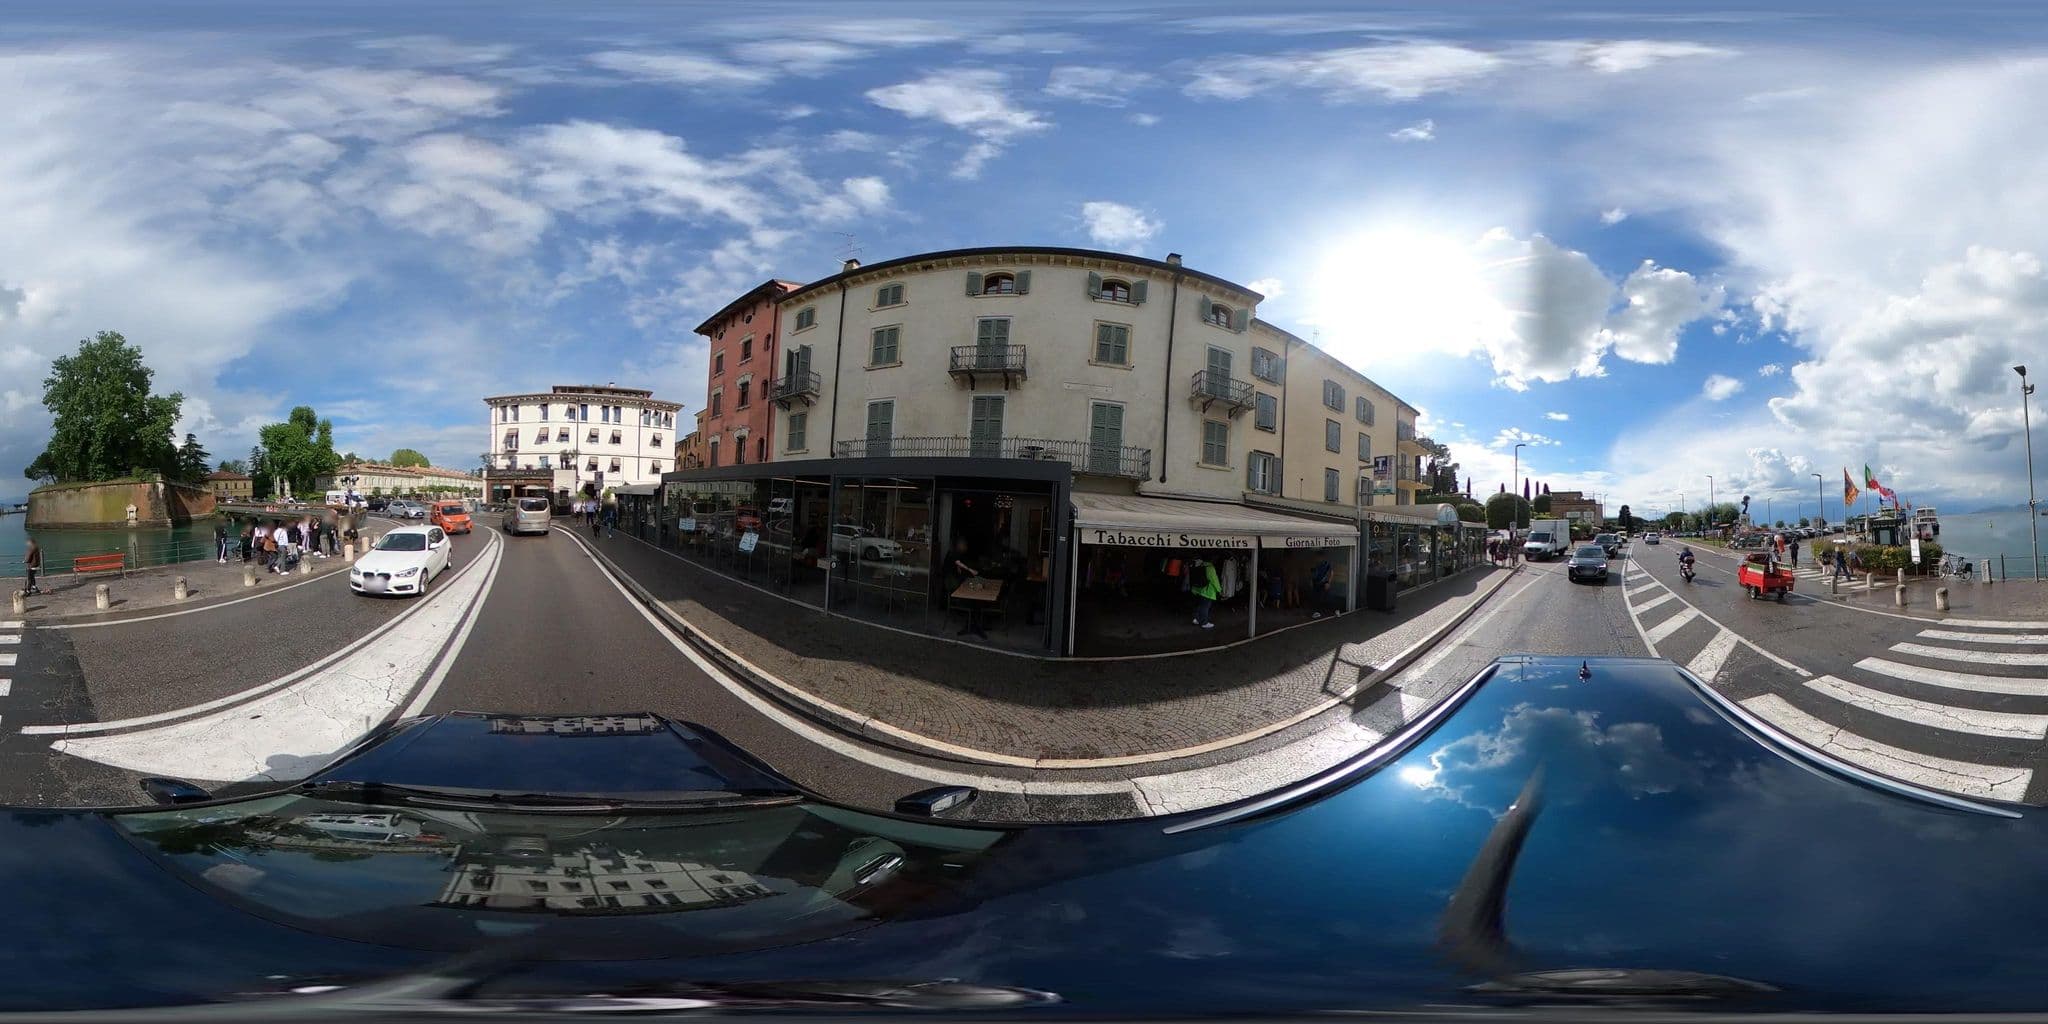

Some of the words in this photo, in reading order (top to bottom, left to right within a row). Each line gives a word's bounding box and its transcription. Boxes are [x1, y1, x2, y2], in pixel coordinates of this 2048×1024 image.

[1095, 530, 1171, 546] Tabacchi
[1179, 534, 1248, 547] Souvenirs
[1286, 536, 1321, 547] Giornali
[1324, 536, 1341, 546] Foto
